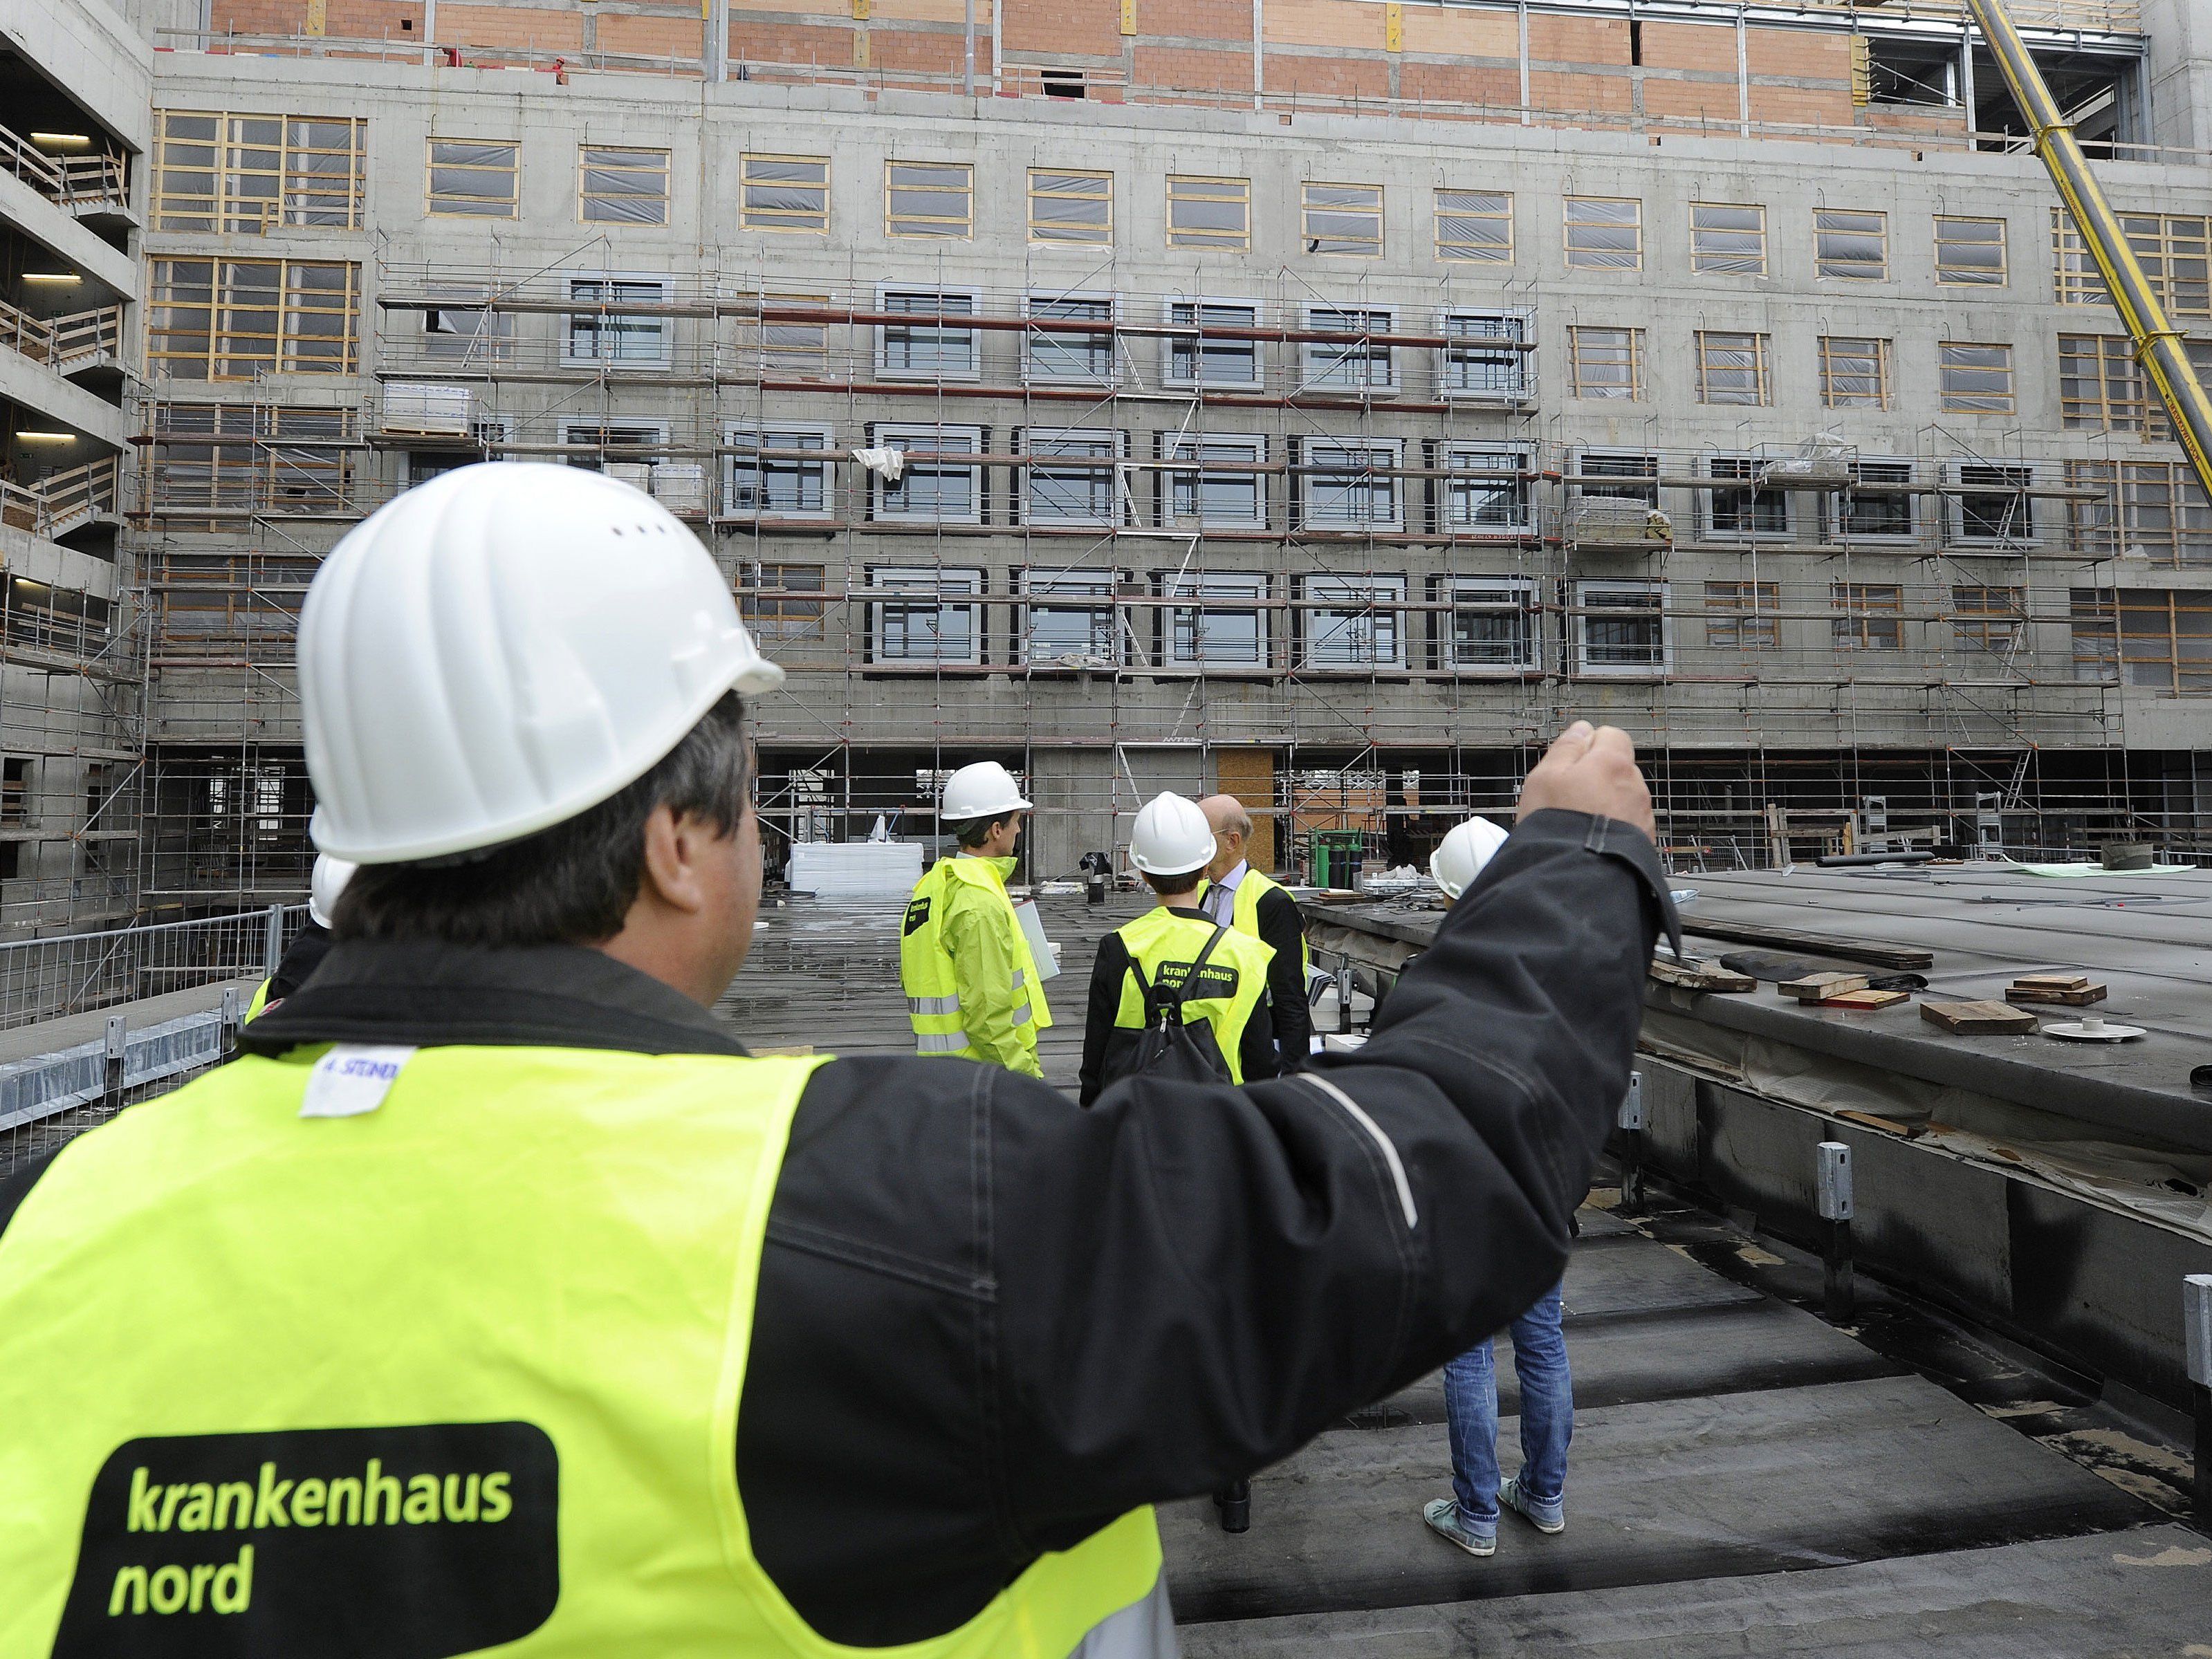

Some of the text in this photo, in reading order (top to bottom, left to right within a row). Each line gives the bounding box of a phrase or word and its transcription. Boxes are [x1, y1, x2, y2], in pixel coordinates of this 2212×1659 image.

[1162, 979, 1184, 989] nor
[1163, 965, 1233, 982] krannhaus
[127, 1458, 513, 1533] krankenhaus
[108, 1544, 255, 1617] nord
